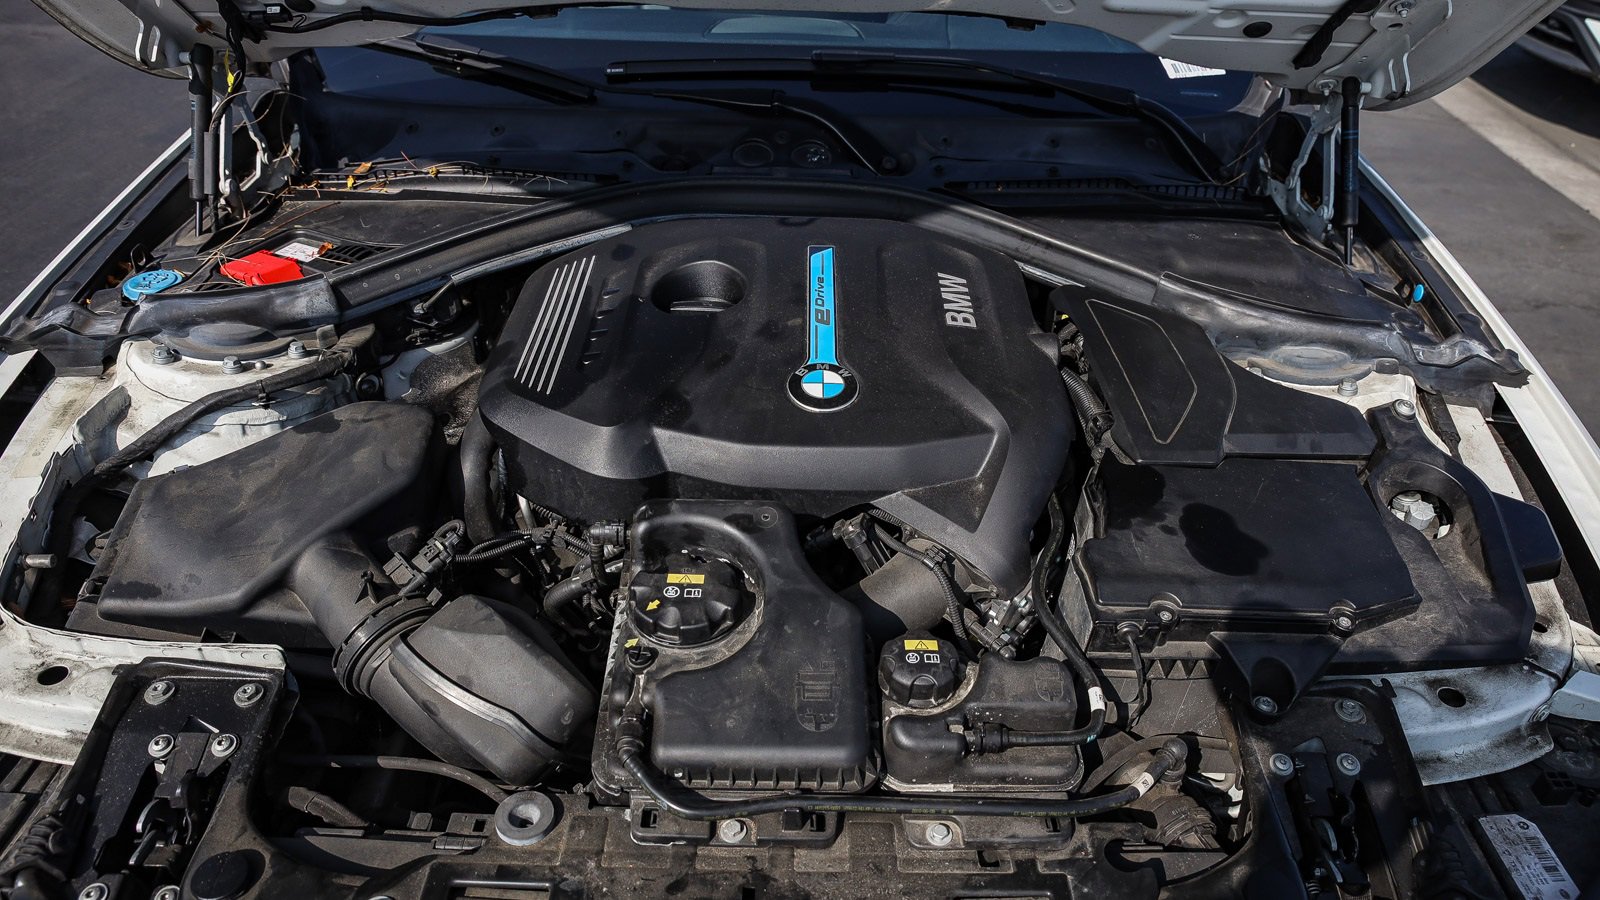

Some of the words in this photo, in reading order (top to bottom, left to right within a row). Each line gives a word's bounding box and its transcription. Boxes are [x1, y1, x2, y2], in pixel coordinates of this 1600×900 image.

[814, 276, 831, 326] eDrive
[937, 272, 977, 328] BMW
[795, 363, 851, 377] BMW
